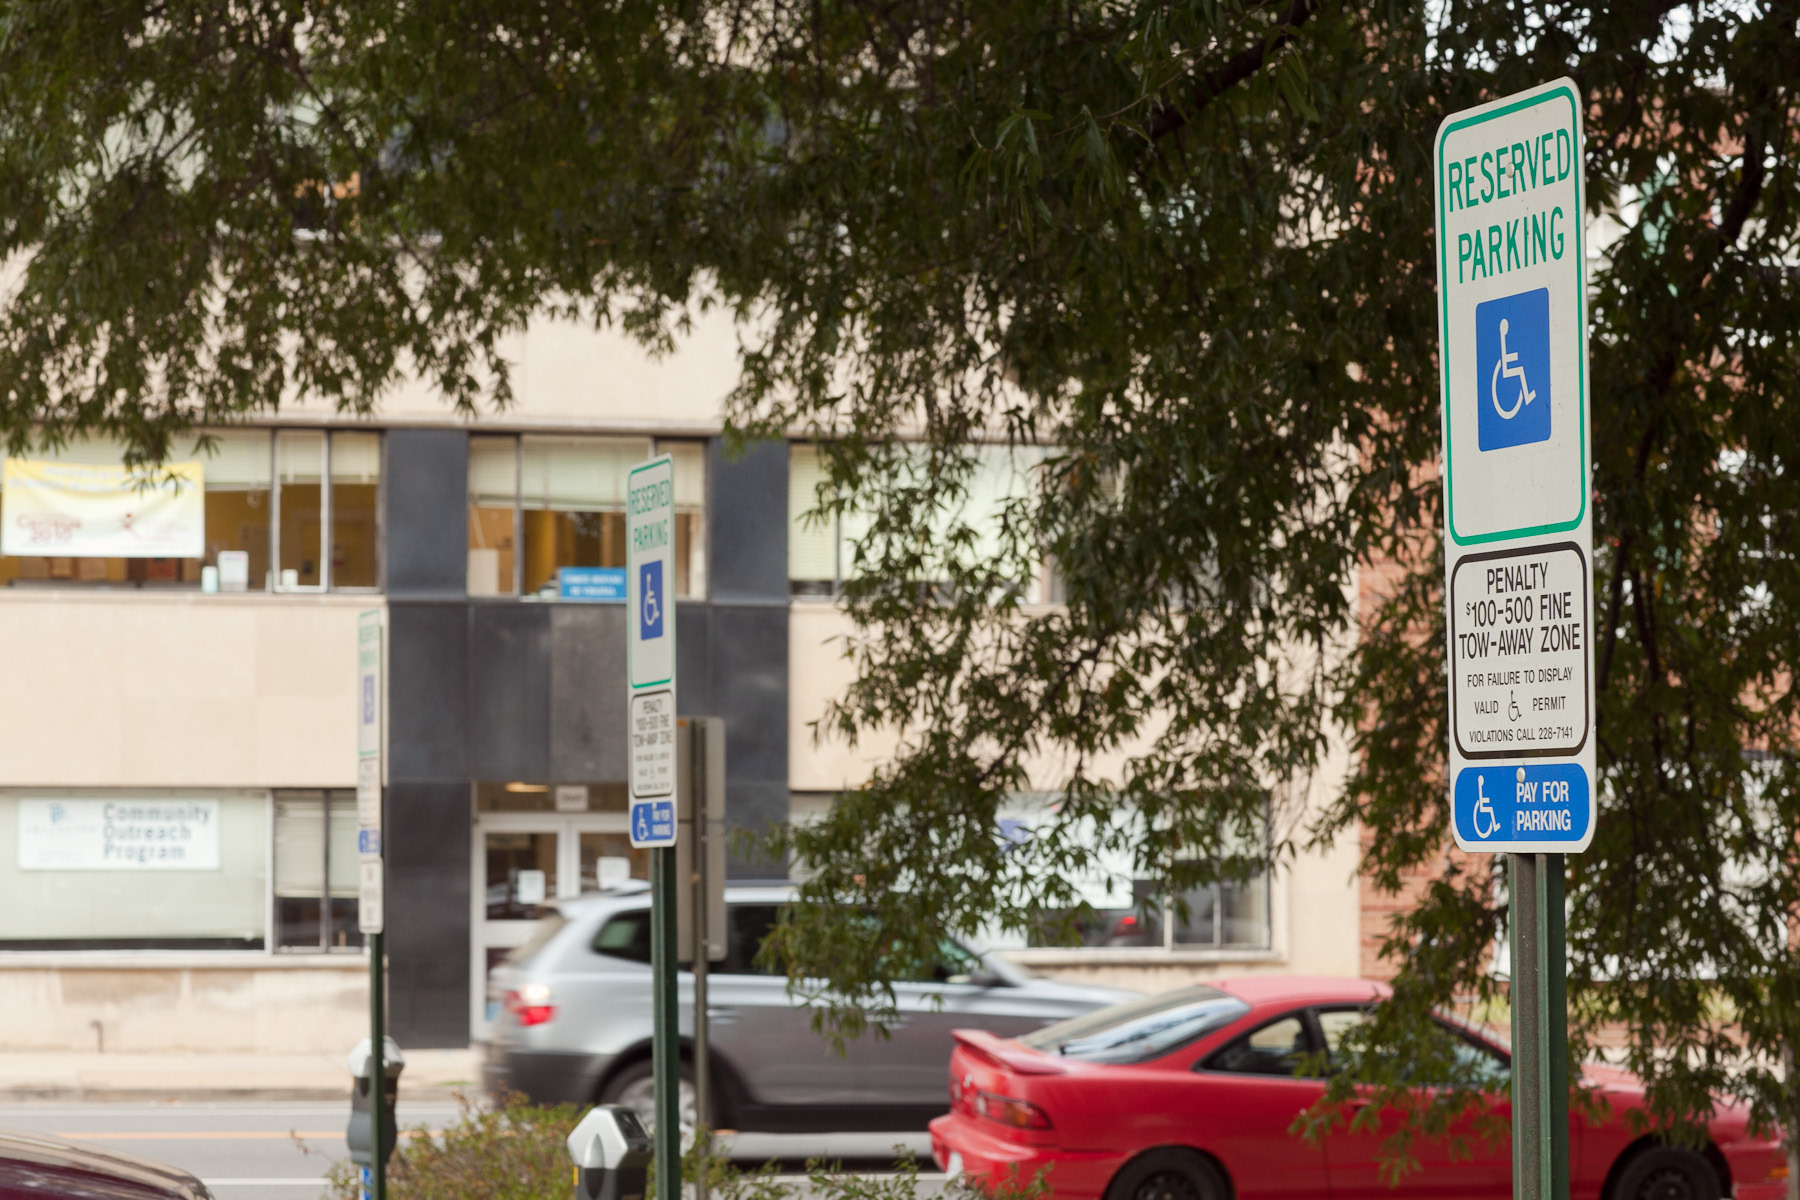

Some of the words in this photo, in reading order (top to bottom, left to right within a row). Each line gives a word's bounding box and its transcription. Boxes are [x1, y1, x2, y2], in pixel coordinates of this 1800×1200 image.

[1448, 127, 1571, 213] RESERVED
[1458, 206, 1565, 284] PARKING
[631, 480, 670, 516] RESERVED
[633, 519, 668, 554] PARKING
[1486, 561, 1549, 595] PENALTY
[1465, 595, 1534, 627] $100-500
[1540, 591, 1572, 621] FINE
[1459, 627, 1534, 660] TOW-AWAY
[1540, 622, 1581, 652] ZONE
[1467, 672, 1485, 688] FOR
[1487, 670, 1521, 686] FAILURE
[1523, 669, 1535, 684] TO
[1538, 666, 1573, 682] DISPLAY
[1474, 700, 1499, 715] VALID
[1532, 695, 1567, 711] PERMIT
[1469, 729, 1514, 743] VIOLATIONS
[1516, 728, 1536, 741] CALL
[1538, 726, 1573, 740] 228-7141
[1516, 781, 1538, 804] PAY
[1542, 780, 1570, 803] FOR
[103, 802, 211, 825] Community
[1516, 808, 1572, 832] PARKING
[103, 823, 192, 840] Outreach
[103, 842, 186, 863] Program
